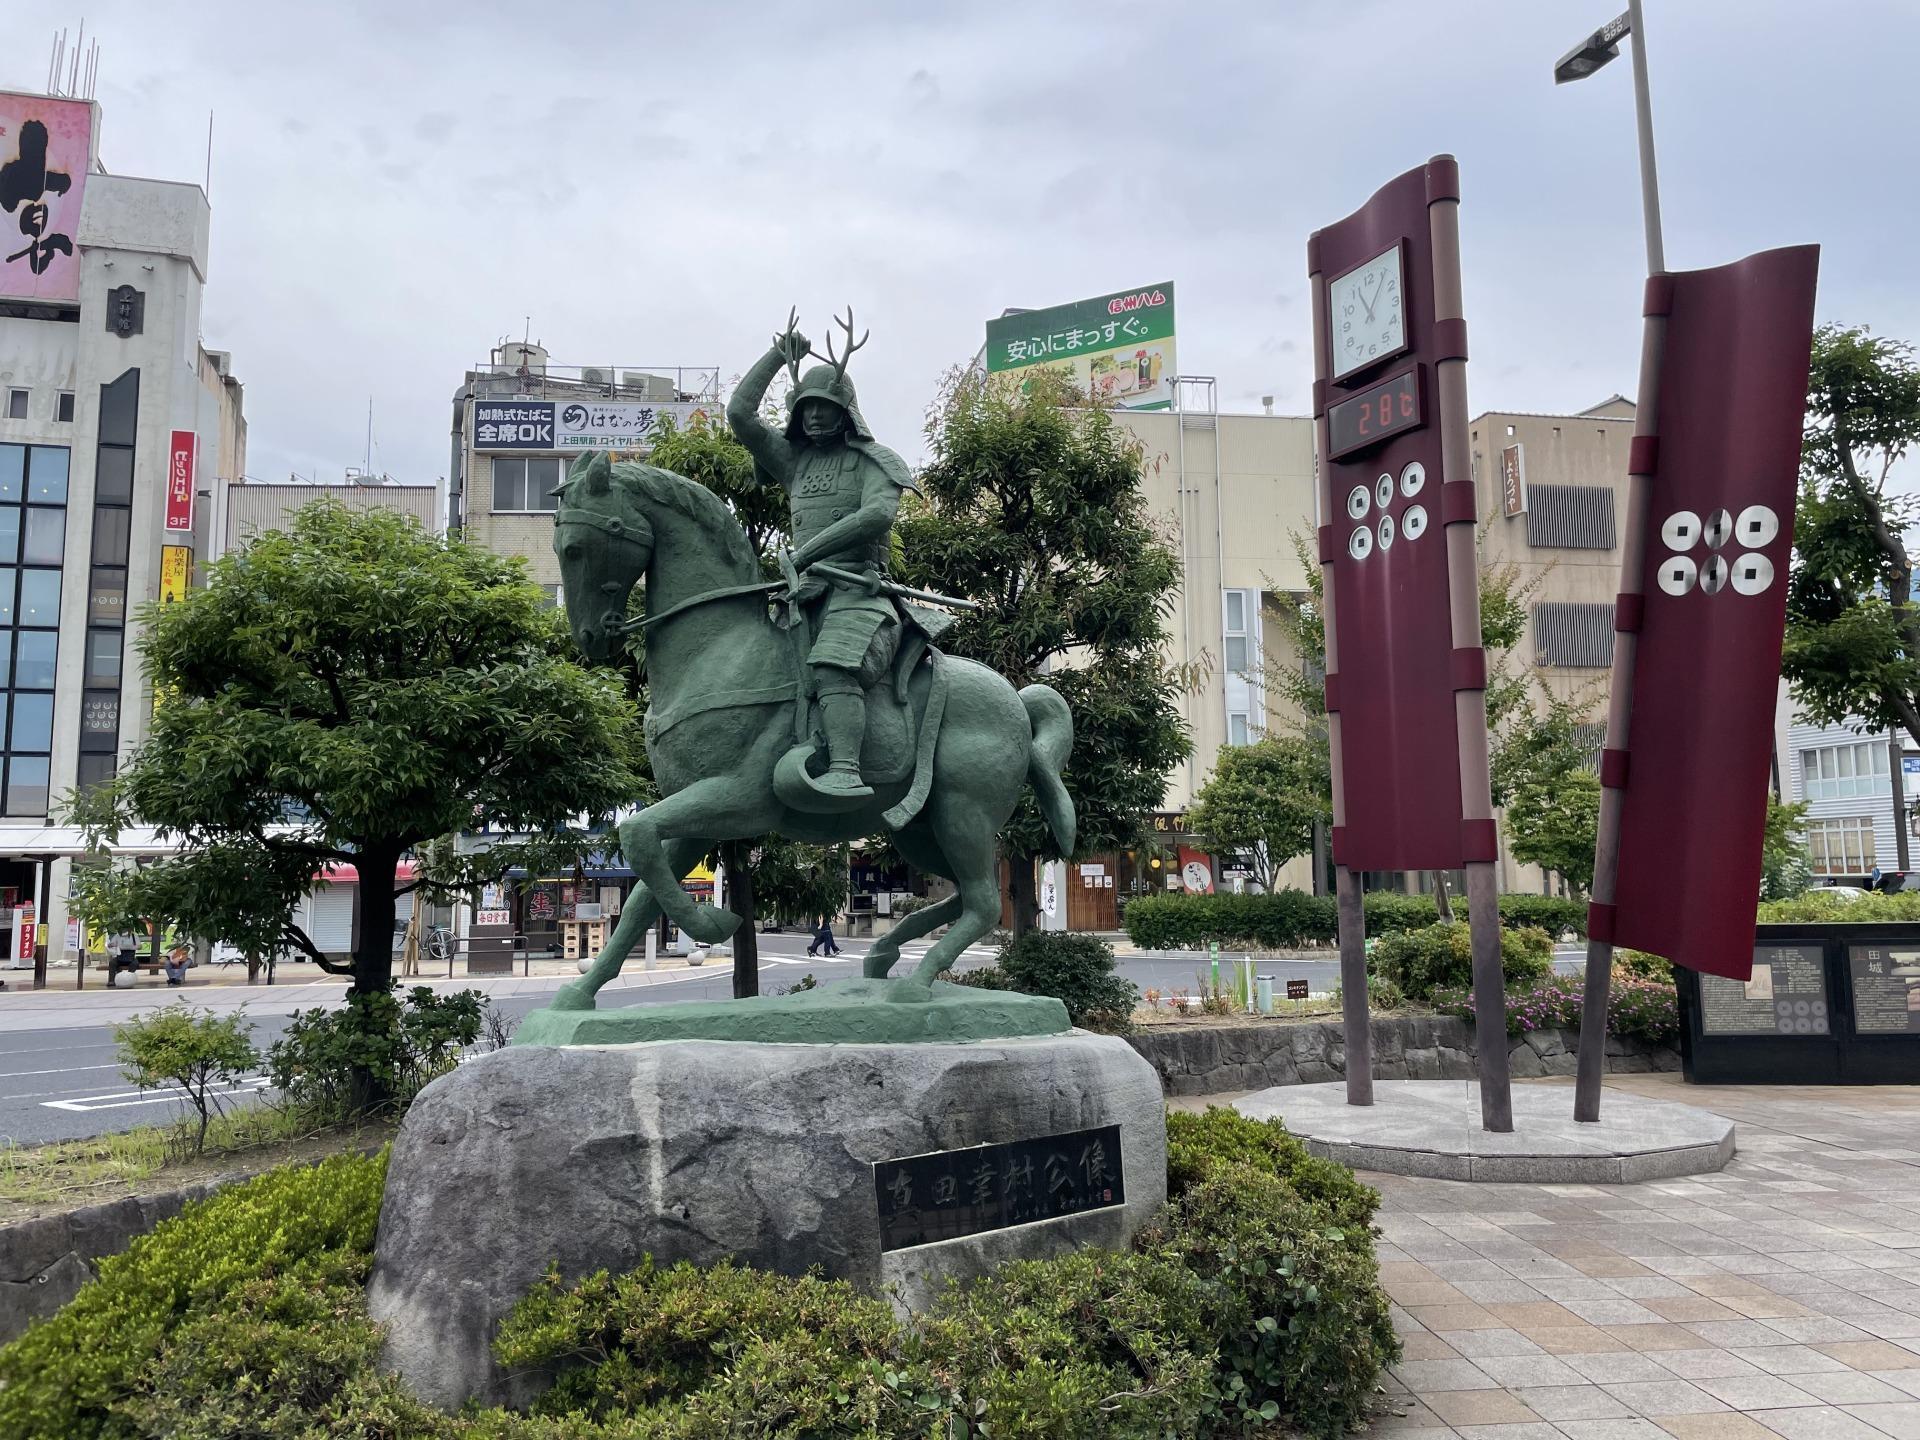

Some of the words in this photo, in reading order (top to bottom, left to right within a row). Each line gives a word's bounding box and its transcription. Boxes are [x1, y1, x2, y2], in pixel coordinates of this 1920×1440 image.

[1364, 273, 1374, 288] 12
[1387, 280, 1395, 292] 2
[1108, 290, 1166, 315] 信州ハム
[1391, 295, 1399, 307] 3
[1344, 304, 1355, 317] 10
[1389, 314, 1397, 326] 4
[1343, 321, 1351, 332] 9
[1007, 316, 1149, 363] 安心にまっすぐ。
[1346, 336, 1355, 348] 8
[1382, 331, 1390, 344] 5
[1356, 344, 1364, 356] 7
[1368, 344, 1377, 355] 6
[478, 408, 552, 421] 加熱式たばこ
[478, 423, 552, 442] 全席OK
[561, 436, 597, 445] 上田駅前
[174, 451, 188, 503] ビッグエコー
[170, 517, 188, 526] 3F
[479, 912, 508, 923] 毎日営業
[23, 925, 31, 958] カラオケ
[886, 1137, 1117, 1229] 真田幸村公像
